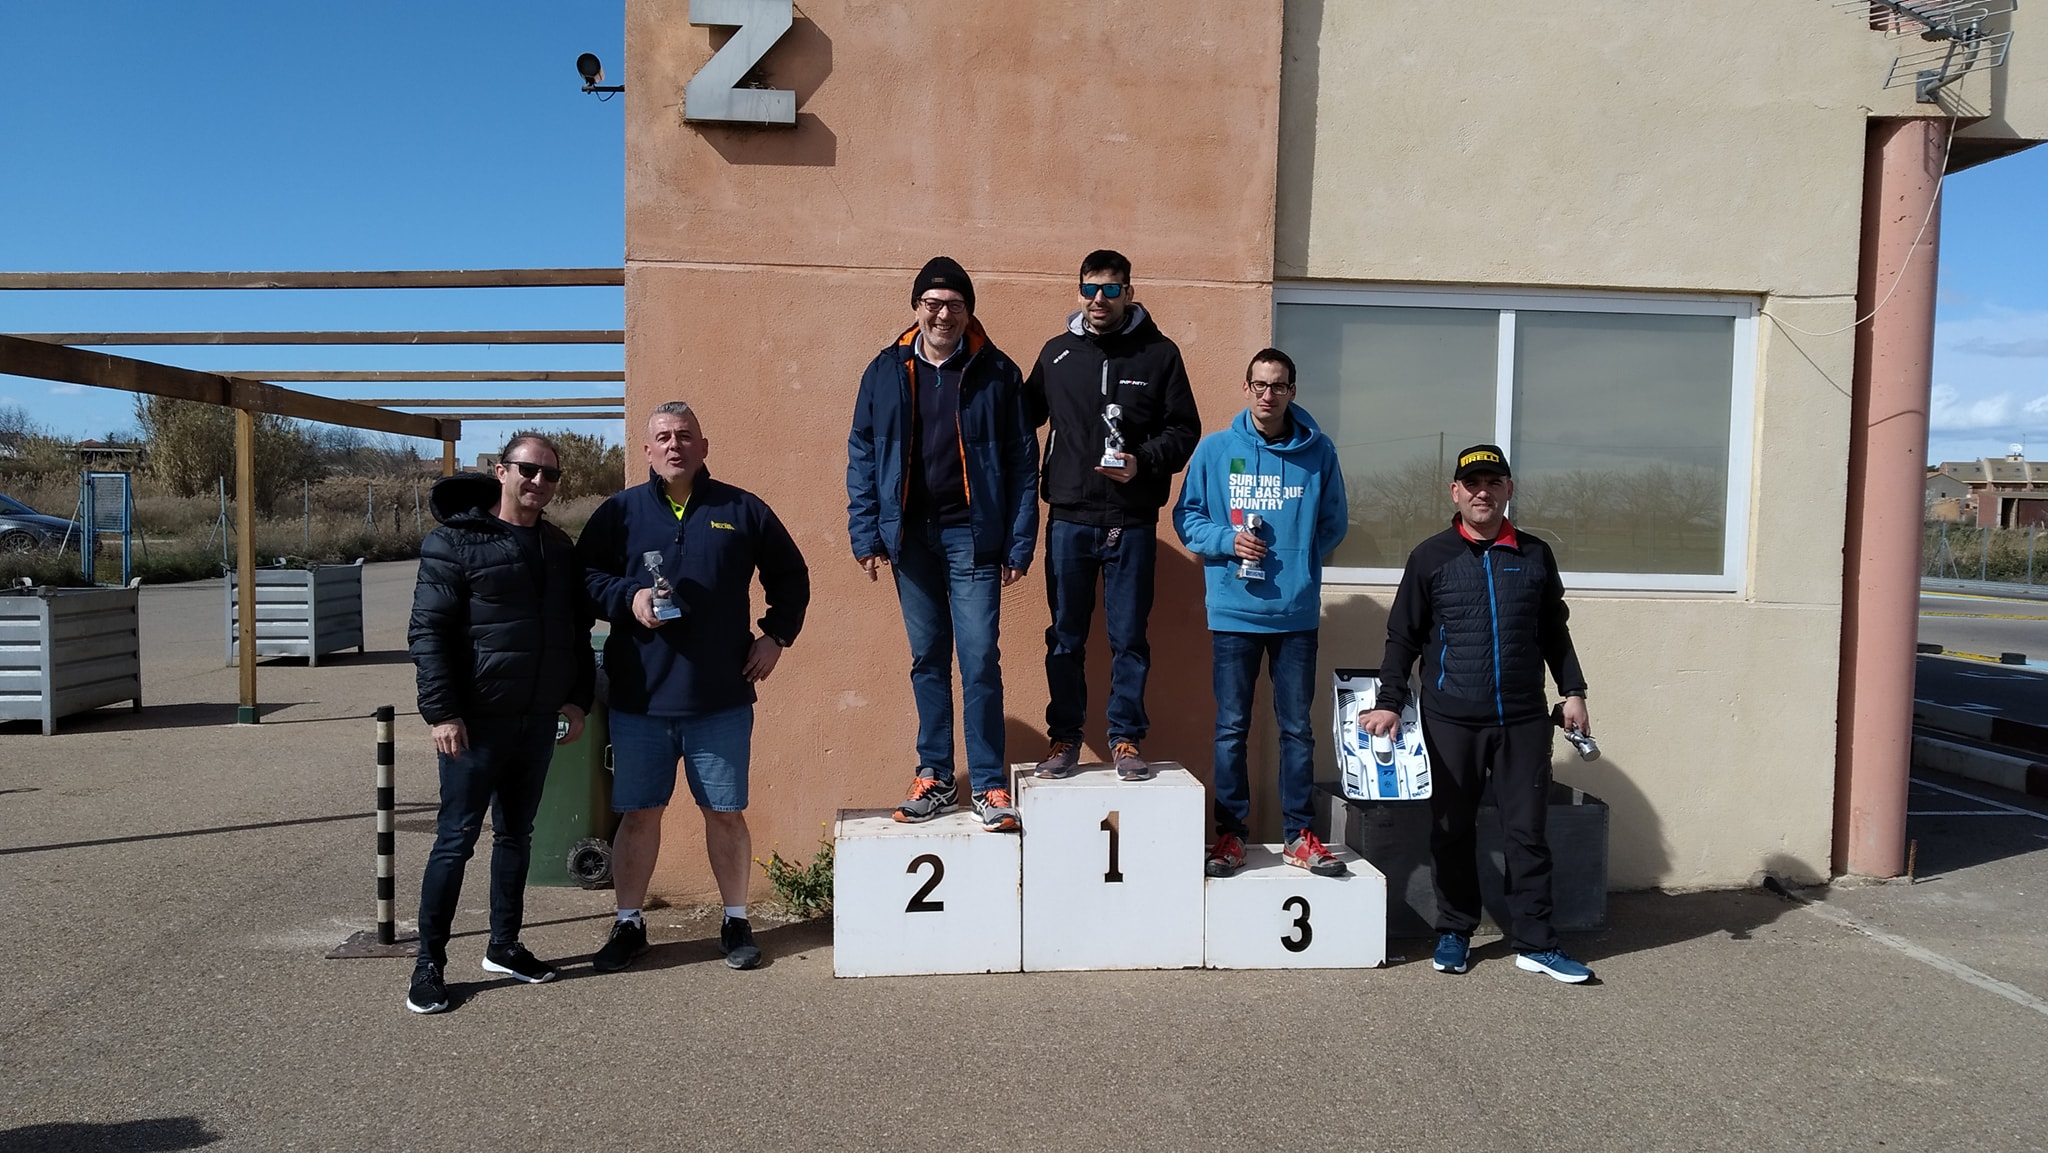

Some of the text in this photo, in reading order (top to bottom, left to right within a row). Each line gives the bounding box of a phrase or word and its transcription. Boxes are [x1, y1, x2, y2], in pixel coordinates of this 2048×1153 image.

[1460, 451, 1499, 467] PIRELLI
[1229, 486, 1304, 499] THE BASQUE
[1230, 498, 1284, 510] COUNTRY
[1100, 811, 1124, 883] 1
[905, 854, 945, 914] 2
[1280, 896, 1313, 953] 3
